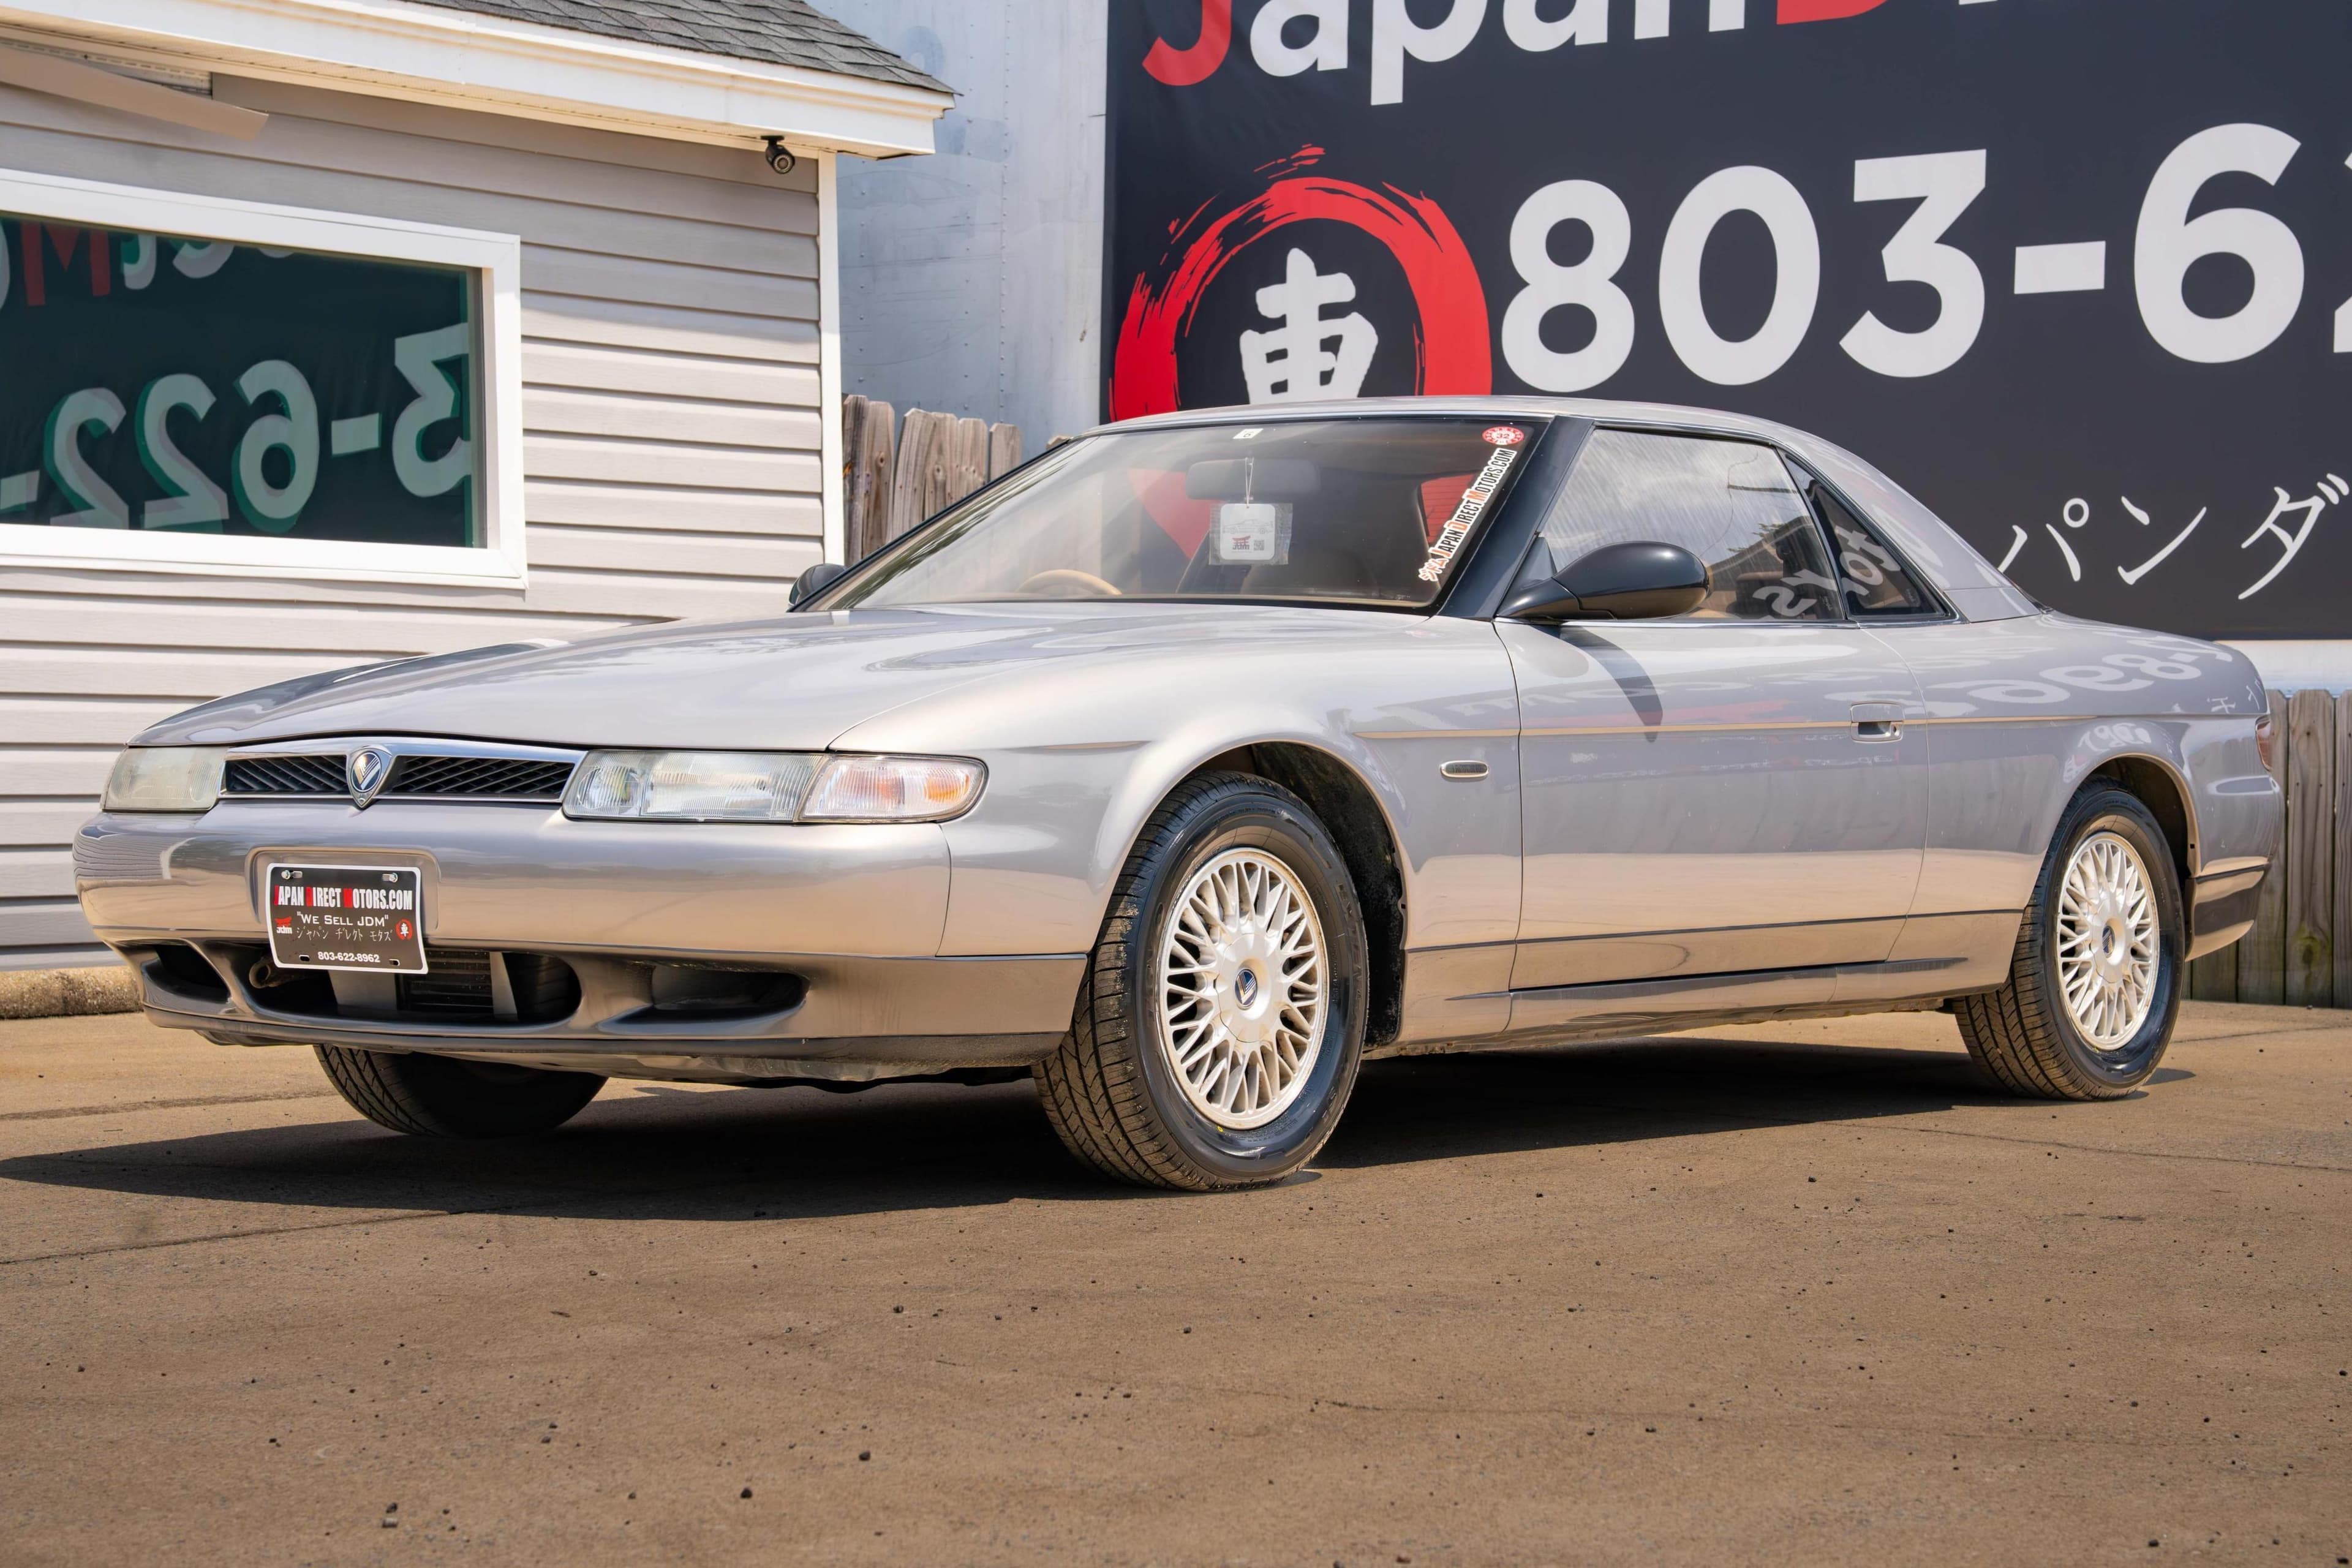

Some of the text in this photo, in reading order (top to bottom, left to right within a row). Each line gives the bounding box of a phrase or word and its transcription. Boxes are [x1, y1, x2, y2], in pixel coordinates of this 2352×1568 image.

[1501, 123, 2352, 392] 803-6
[274, 884, 304, 907] JAPAN
[317, 951, 381, 963] 803-622-8962
